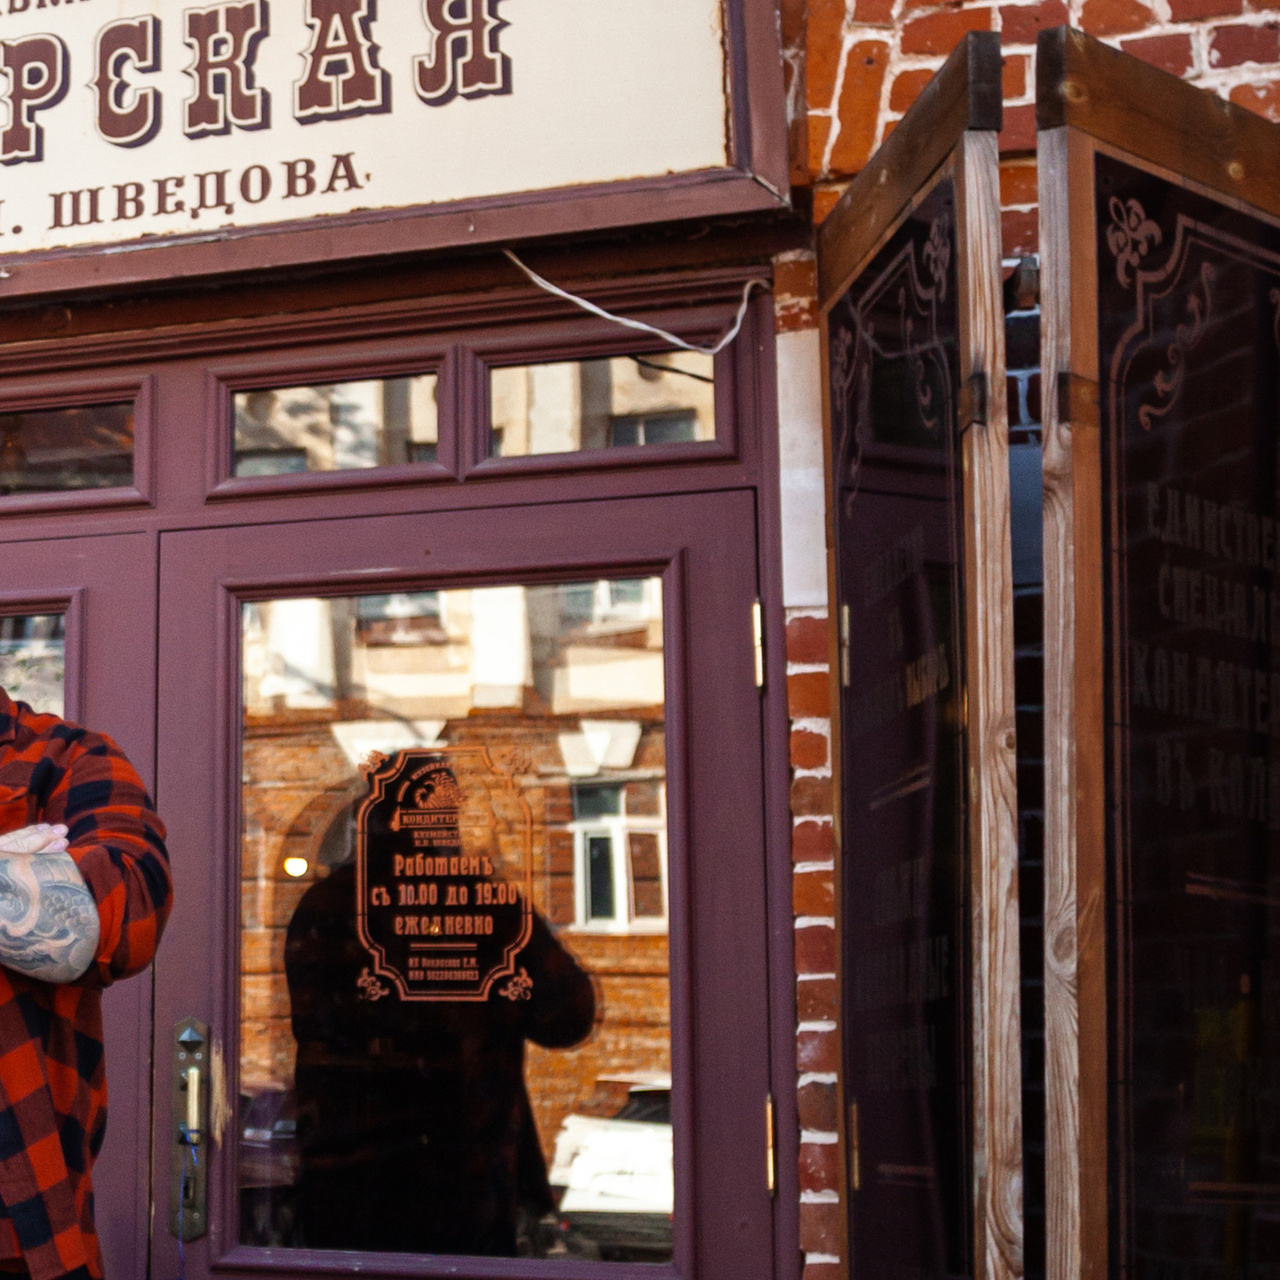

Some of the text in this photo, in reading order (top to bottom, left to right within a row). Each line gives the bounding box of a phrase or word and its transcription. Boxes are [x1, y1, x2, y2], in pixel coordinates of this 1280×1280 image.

[394, 853, 494, 877] Работаемъ
[371, 885, 391, 907] съ
[398, 883, 438, 907] 10.00
[445, 885, 469, 907] до
[395, 915, 494, 937] ежедневно
